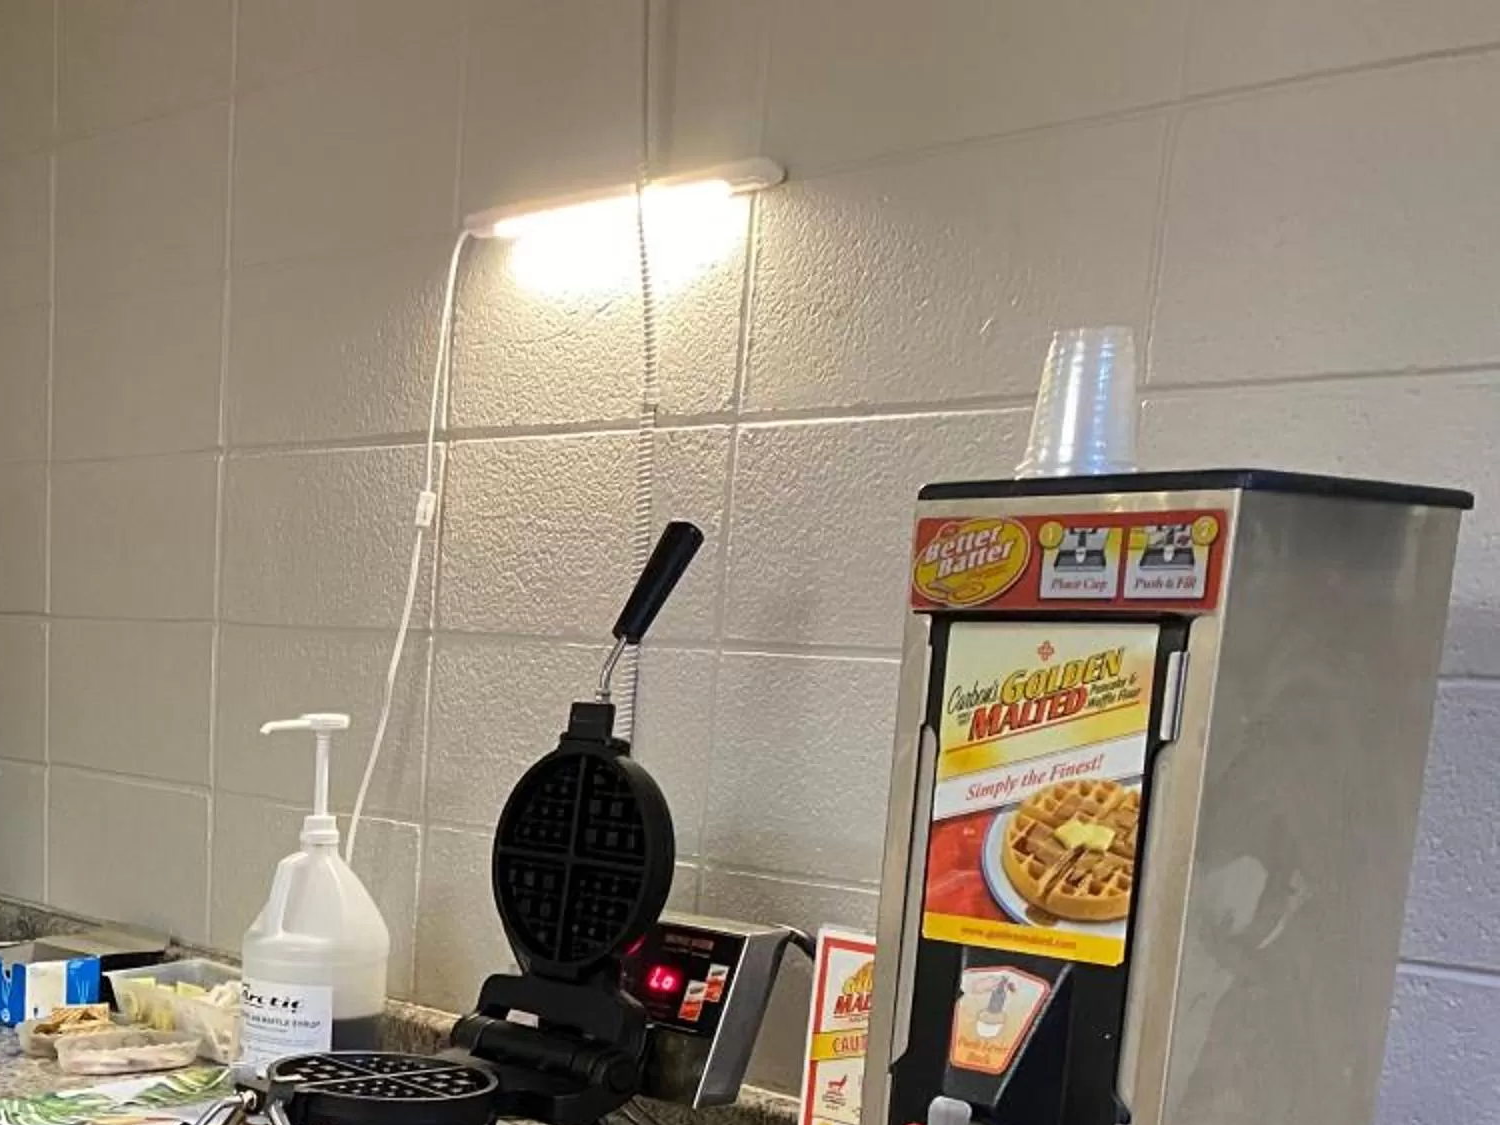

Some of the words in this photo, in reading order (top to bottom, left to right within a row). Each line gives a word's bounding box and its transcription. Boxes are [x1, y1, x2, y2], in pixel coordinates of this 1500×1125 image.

[1001, 646, 1125, 705] GOLDEN
[968, 686, 1088, 741] MALTED
[966, 776, 1019, 801] Simply
[1021, 768, 1046, 787] the
[1049, 753, 1104, 782] Finest!
